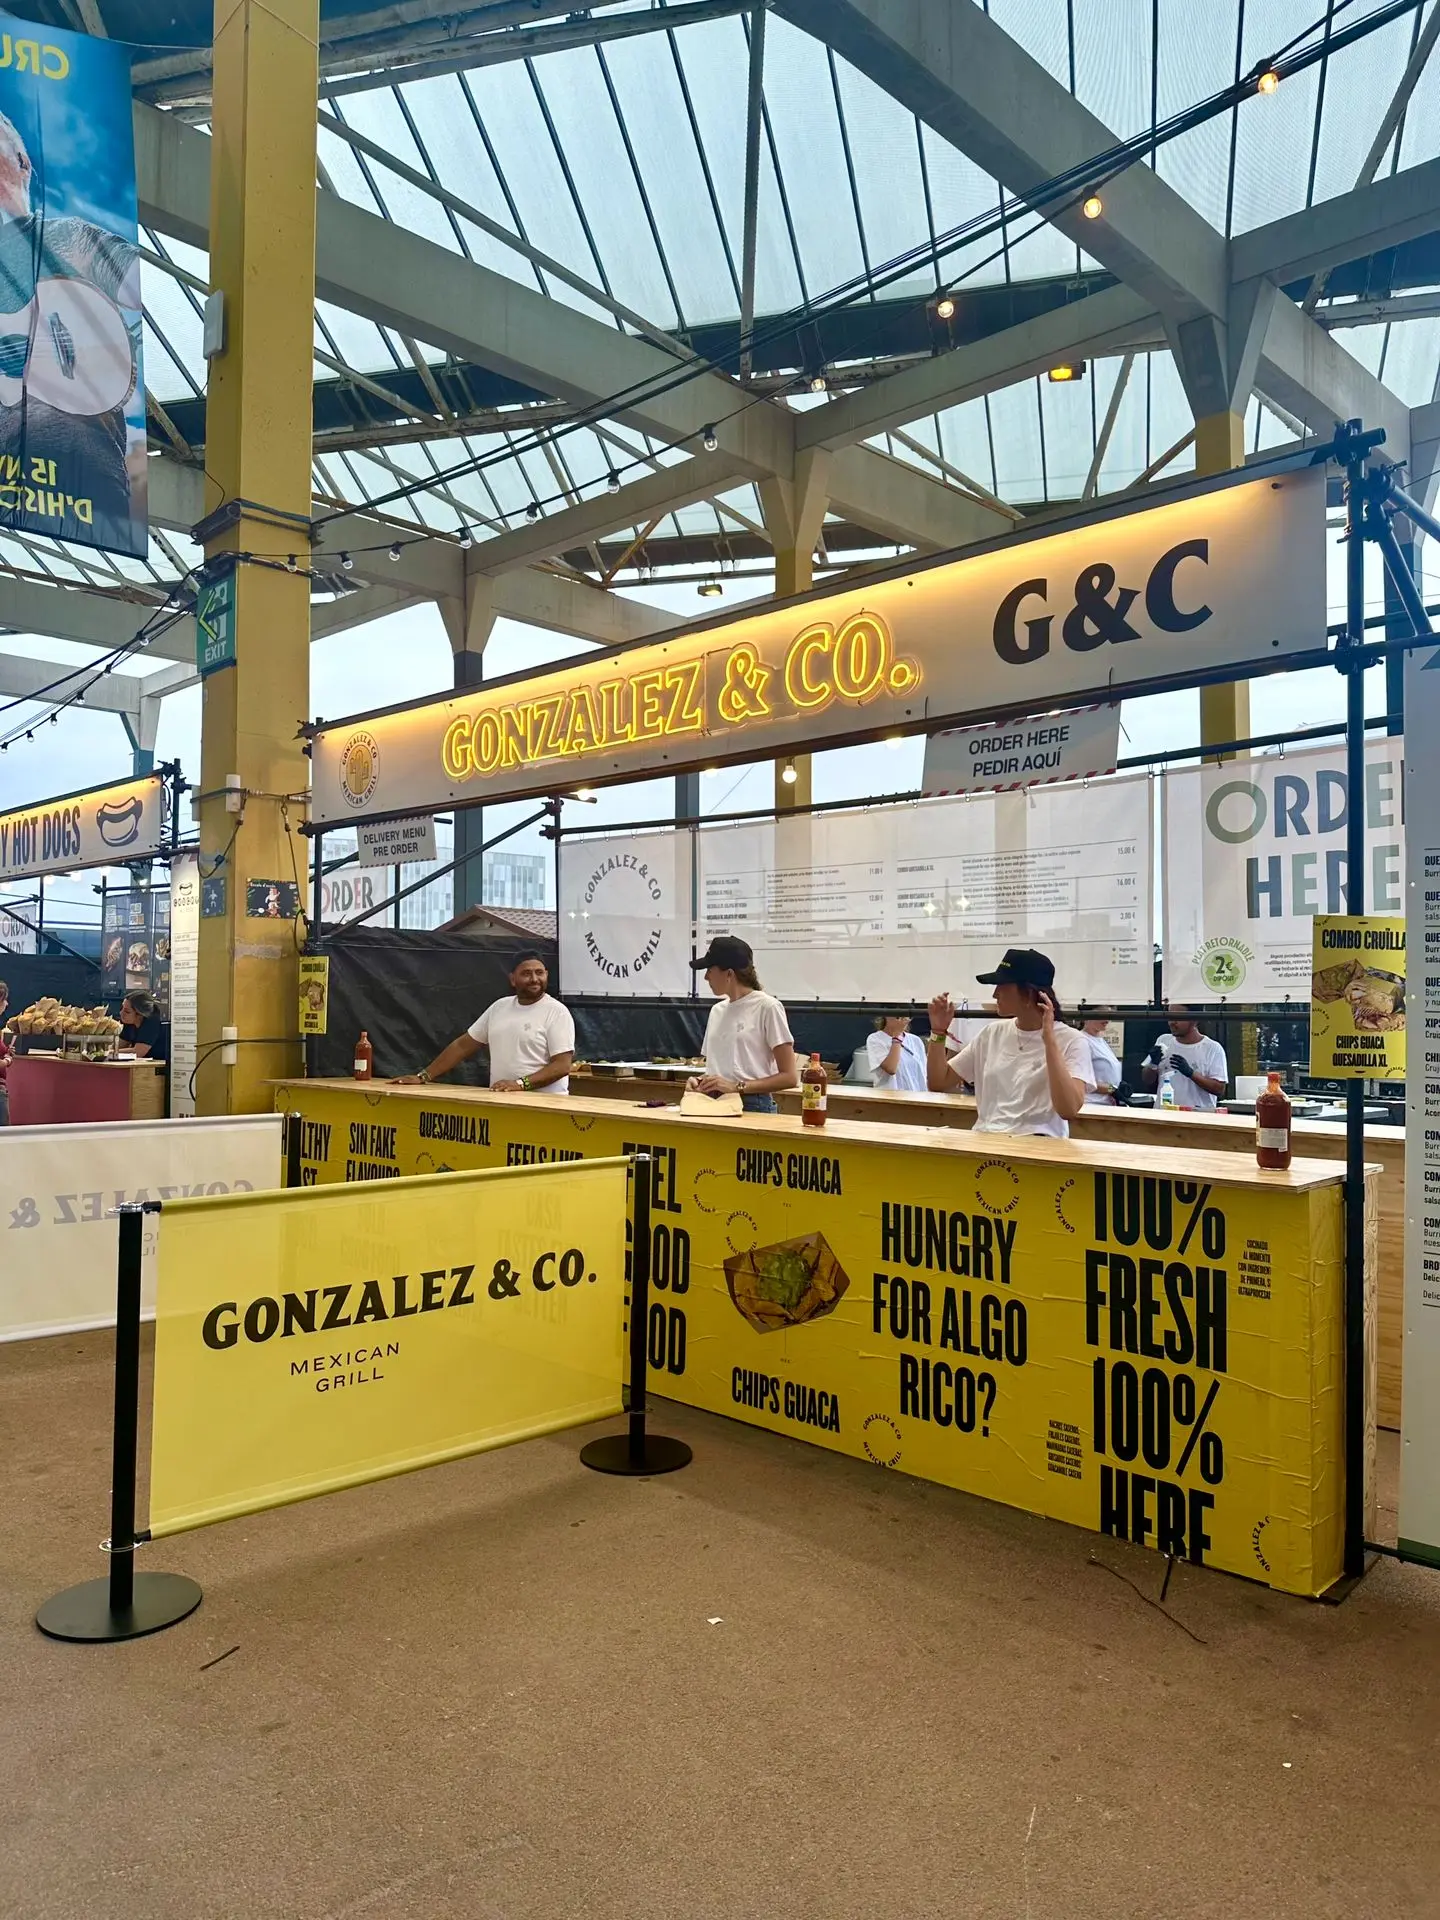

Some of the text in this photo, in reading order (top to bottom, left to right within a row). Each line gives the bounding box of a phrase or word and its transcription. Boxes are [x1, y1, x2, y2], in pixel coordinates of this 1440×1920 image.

[993, 539, 1213, 664] G&C
[205, 641, 226, 662] EXIT
[442, 617, 912, 778] GONZALEZ & CO.
[342, 734, 367, 765] GONZALEZ
[968, 725, 1070, 755] ORDER HERE
[973, 746, 1061, 778] PEDIR AQUÍ
[342, 776, 377, 804] MEXICAN GRILL
[1205, 759, 1405, 844] ORDE
[13, 815, 38, 866] HOT
[42, 805, 81, 860] DOGS
[364, 826, 426, 845] DELIVERY MENU
[373, 842, 418, 857] PRE ORDER
[584, 854, 661, 903] GONZALEZ & CO
[1246, 844, 1401, 919] HERE
[1425, 912, 1440, 921] sals
[584, 929, 661, 978] MEXICAN GRILL
[1204, 936, 1255, 962] RETORNABLE
[1322, 929, 1361, 949] COMBO
[1332, 1053, 1388, 1067] QUESADILLA XL
[1336, 1035, 1385, 1049] CHIPS GUACA
[349, 1122, 366, 1155] SIN
[370, 1125, 397, 1160] FAKE
[419, 1111, 491, 1147] QUESADILLA XL
[736, 1147, 842, 1196] CHIPS GUACA
[974, 1160, 1006, 1179] GONZALEZ
[975, 1191, 1019, 1215] MEXICAN GRILL
[1055, 1192, 1075, 1233] GONZALEZ
[1094, 1172, 1226, 1260] 100%
[881, 1201, 1018, 1284] HUNGRY
[202, 1248, 597, 1350] GONZALEZ & CO.
[1085, 1249, 1228, 1373] FRESH
[873, 1272, 1027, 1367] FOR ALGO
[290, 1342, 400, 1376] MEXICAN
[316, 1368, 385, 1393] GRILL
[900, 1352, 997, 1438] RICO?
[732, 1366, 841, 1434] CHIPS GUACA
[1093, 1356, 1223, 1485] 100%
